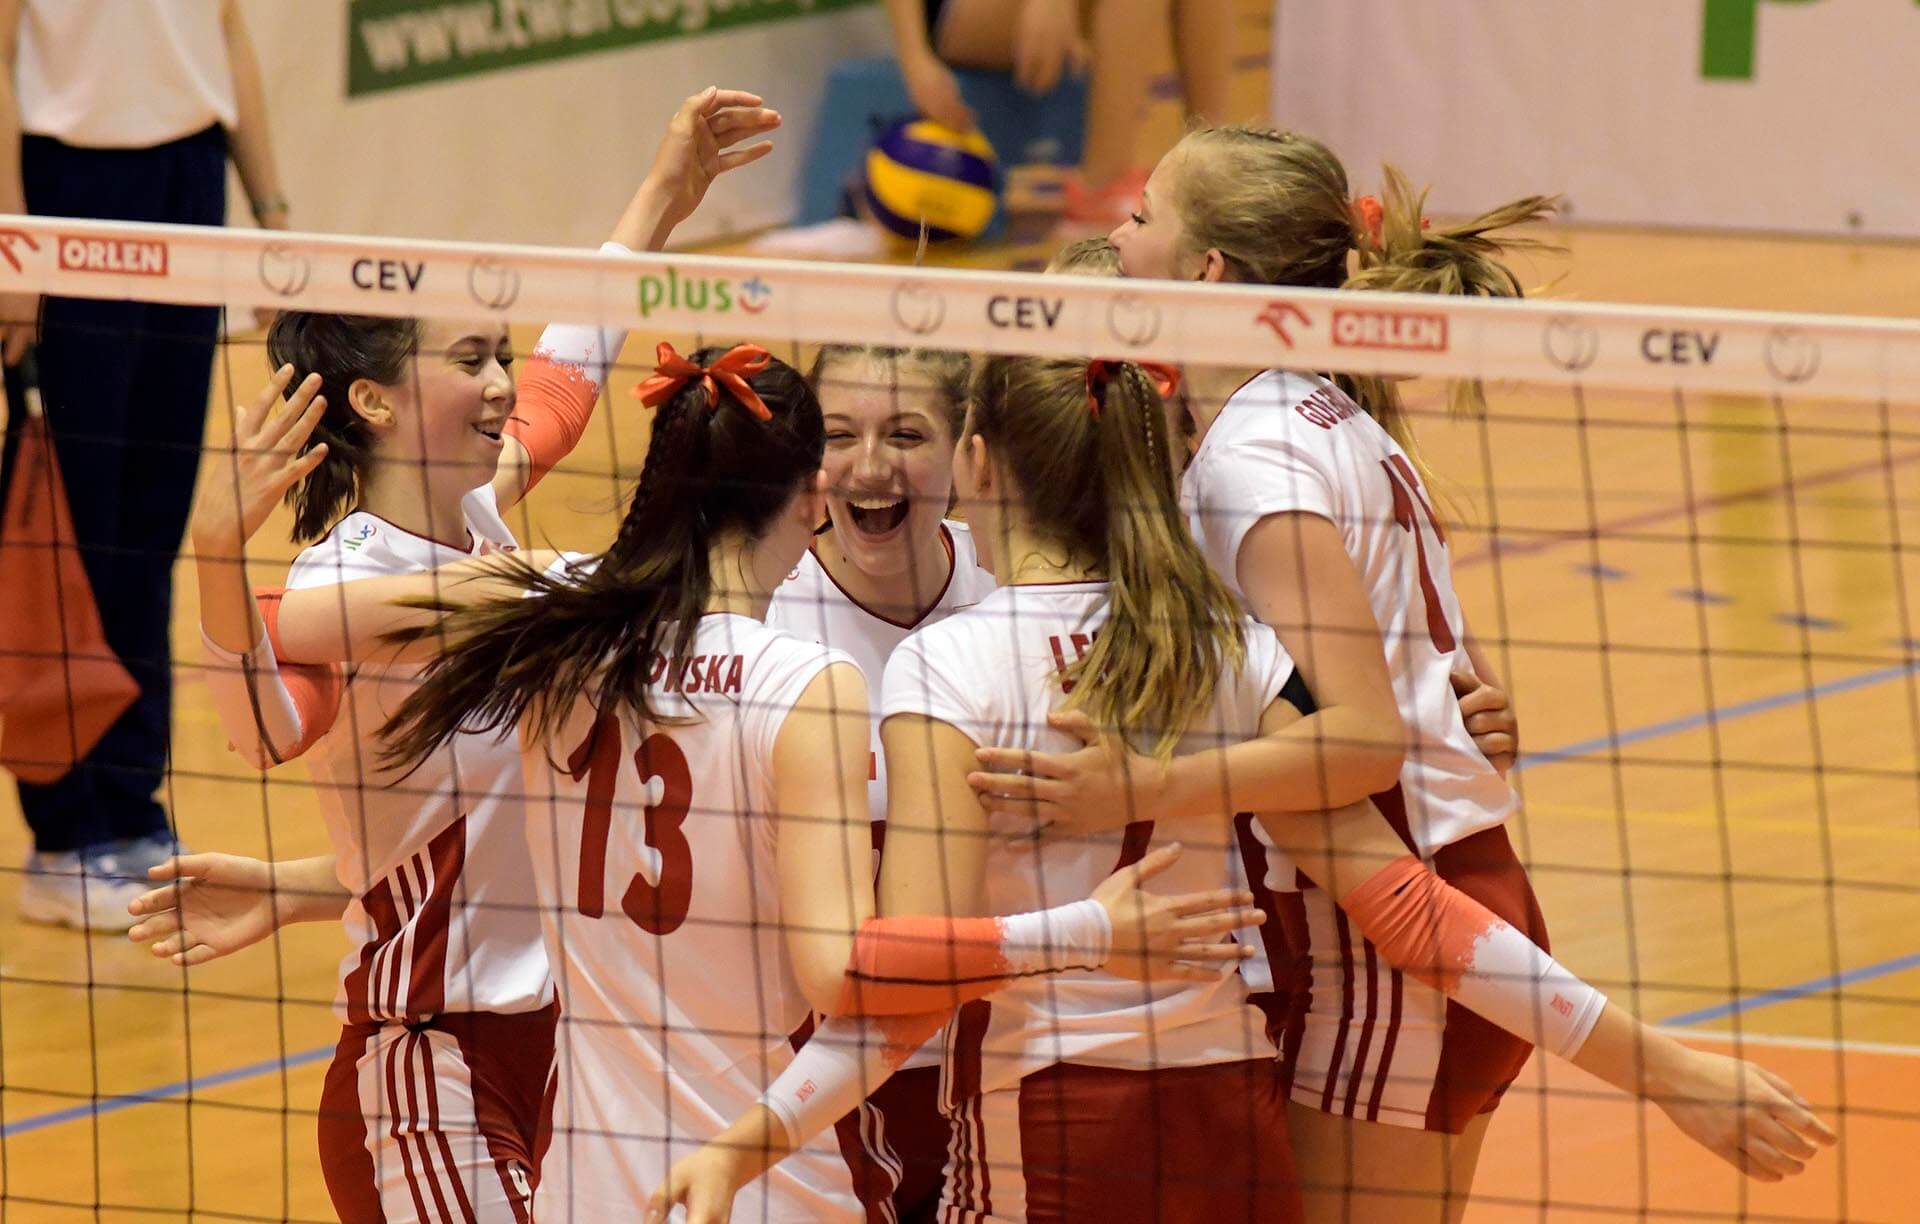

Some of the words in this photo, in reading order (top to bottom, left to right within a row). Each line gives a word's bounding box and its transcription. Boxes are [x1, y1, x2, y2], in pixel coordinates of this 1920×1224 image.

[62, 238, 164, 272] ORLEN
[351, 257, 425, 292] CEV
[638, 266, 732, 317] plus
[986, 295, 1064, 329] CEV
[1336, 314, 1445, 349] ORLEN
[1641, 328, 1721, 364] CEV
[567, 708, 693, 935] 13
